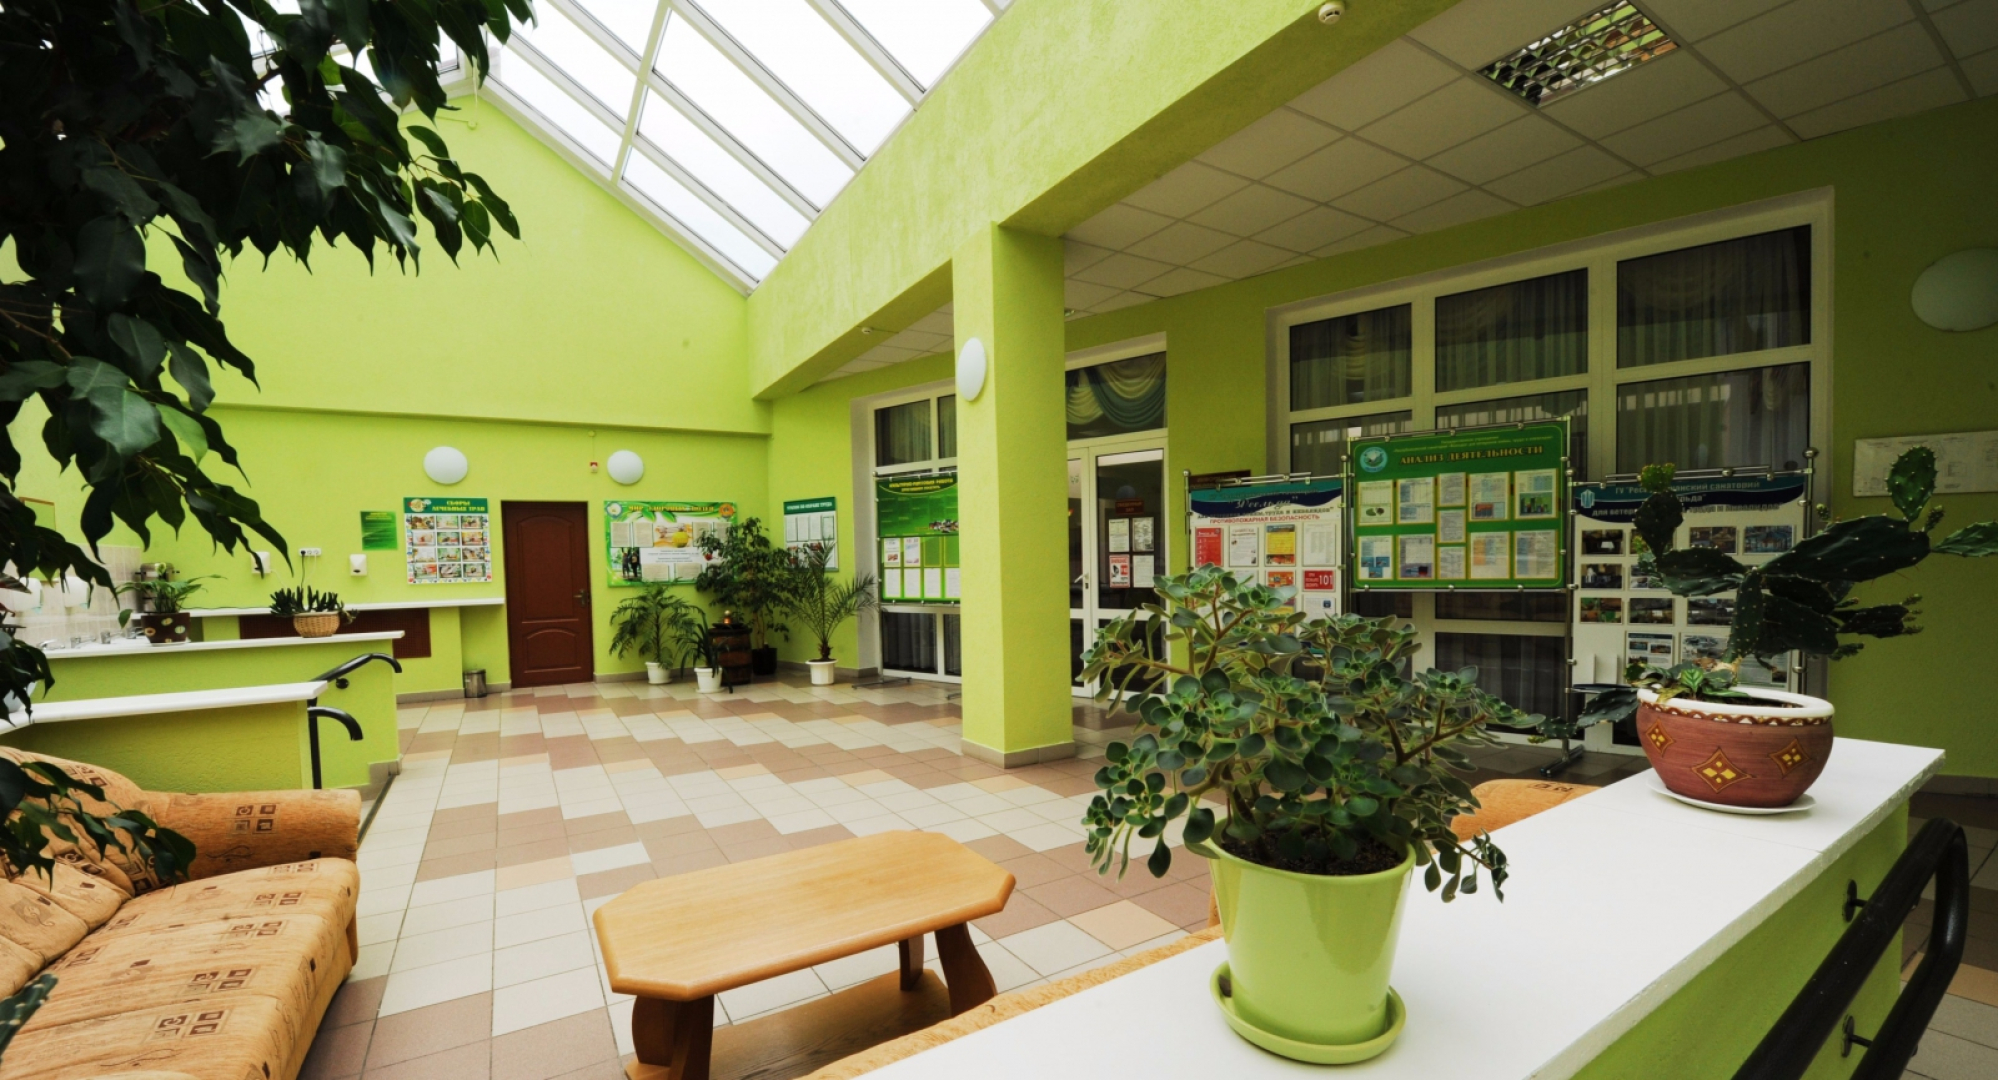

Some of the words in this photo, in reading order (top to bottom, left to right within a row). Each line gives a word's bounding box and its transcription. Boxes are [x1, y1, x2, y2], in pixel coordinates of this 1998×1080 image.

[1400, 453, 1444, 465] АНАЛИЗ
[1447, 445, 1543, 463] ДЕЯТЕЛЬНОСТИ
[1709, 481, 1760, 490] санаторий
[1591, 509, 1608, 518] для
[1210, 516, 1269, 524] ПРОТИВОПОЖАРНАЯ
[1270, 514, 1320, 522] БЕЗОПАСНОСТЬ
[1319, 574, 1333, 586] 101
